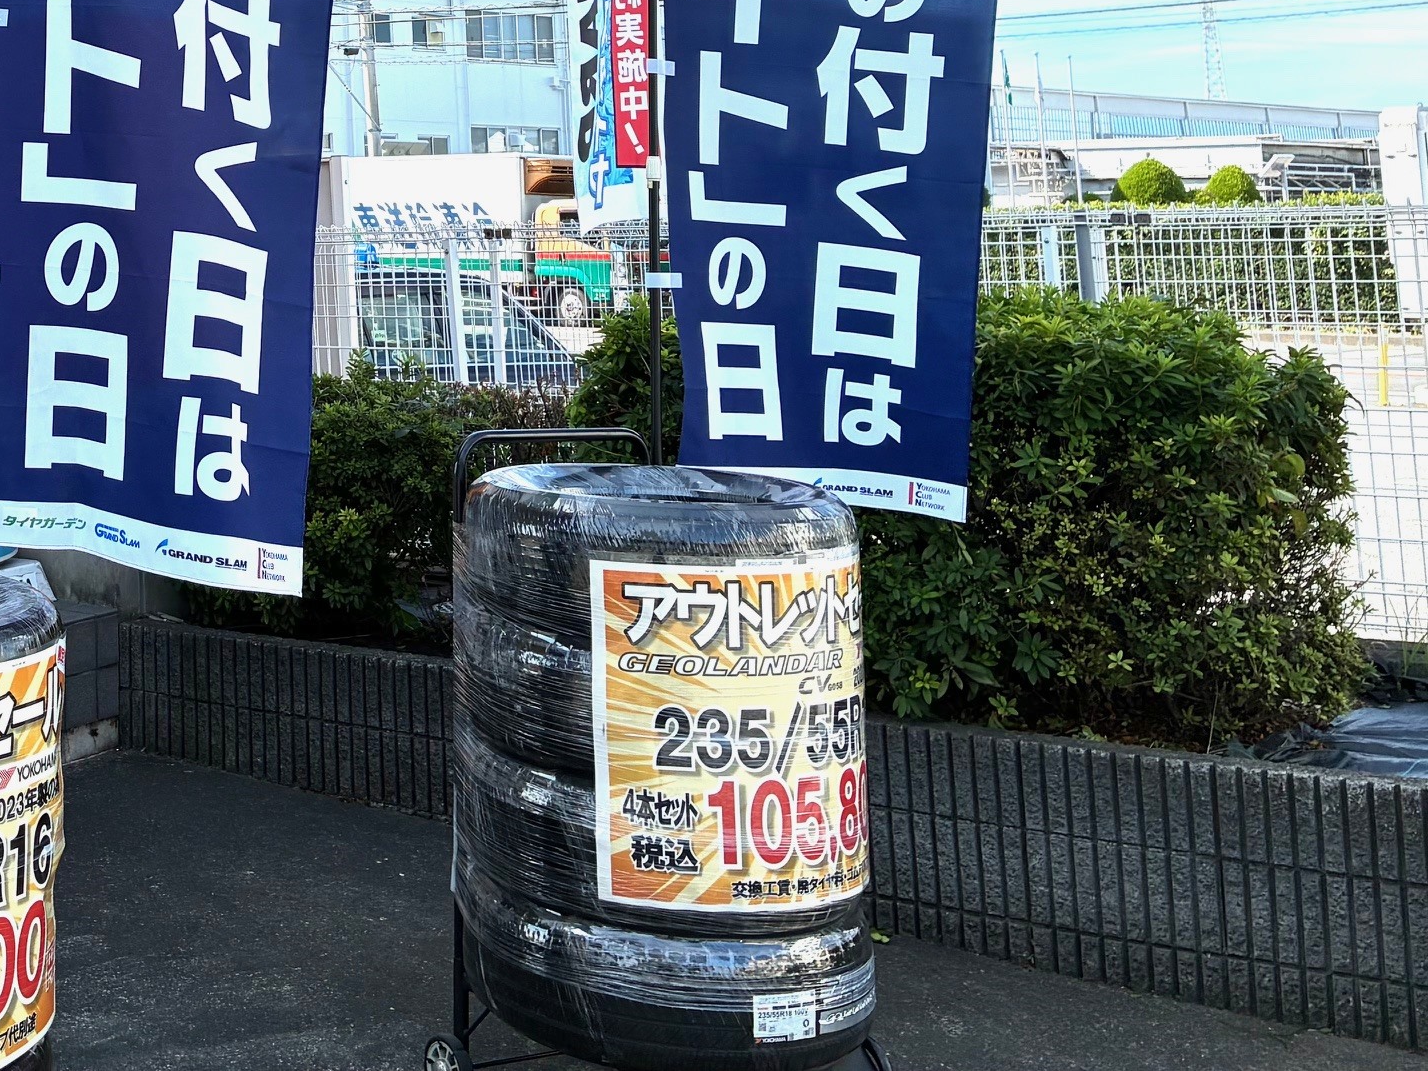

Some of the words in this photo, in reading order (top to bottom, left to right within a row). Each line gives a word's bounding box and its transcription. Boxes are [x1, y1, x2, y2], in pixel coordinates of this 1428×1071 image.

[859, 486, 894, 498] SLAM
[915, 491, 933, 501] CLUB
[916, 482, 951, 496] YOKOHAMA
[915, 500, 945, 512] NETWORK
[3, 515, 87, 530] タイヤガーデン
[167, 549, 214, 565] GRAND
[214, 557, 248, 571] SLAM
[618, 648, 844, 677] GEOLANDAR
[798, 673, 832, 695] CV
[622, 789, 699, 829] 4本セット
[631, 835, 699, 873] 税込
